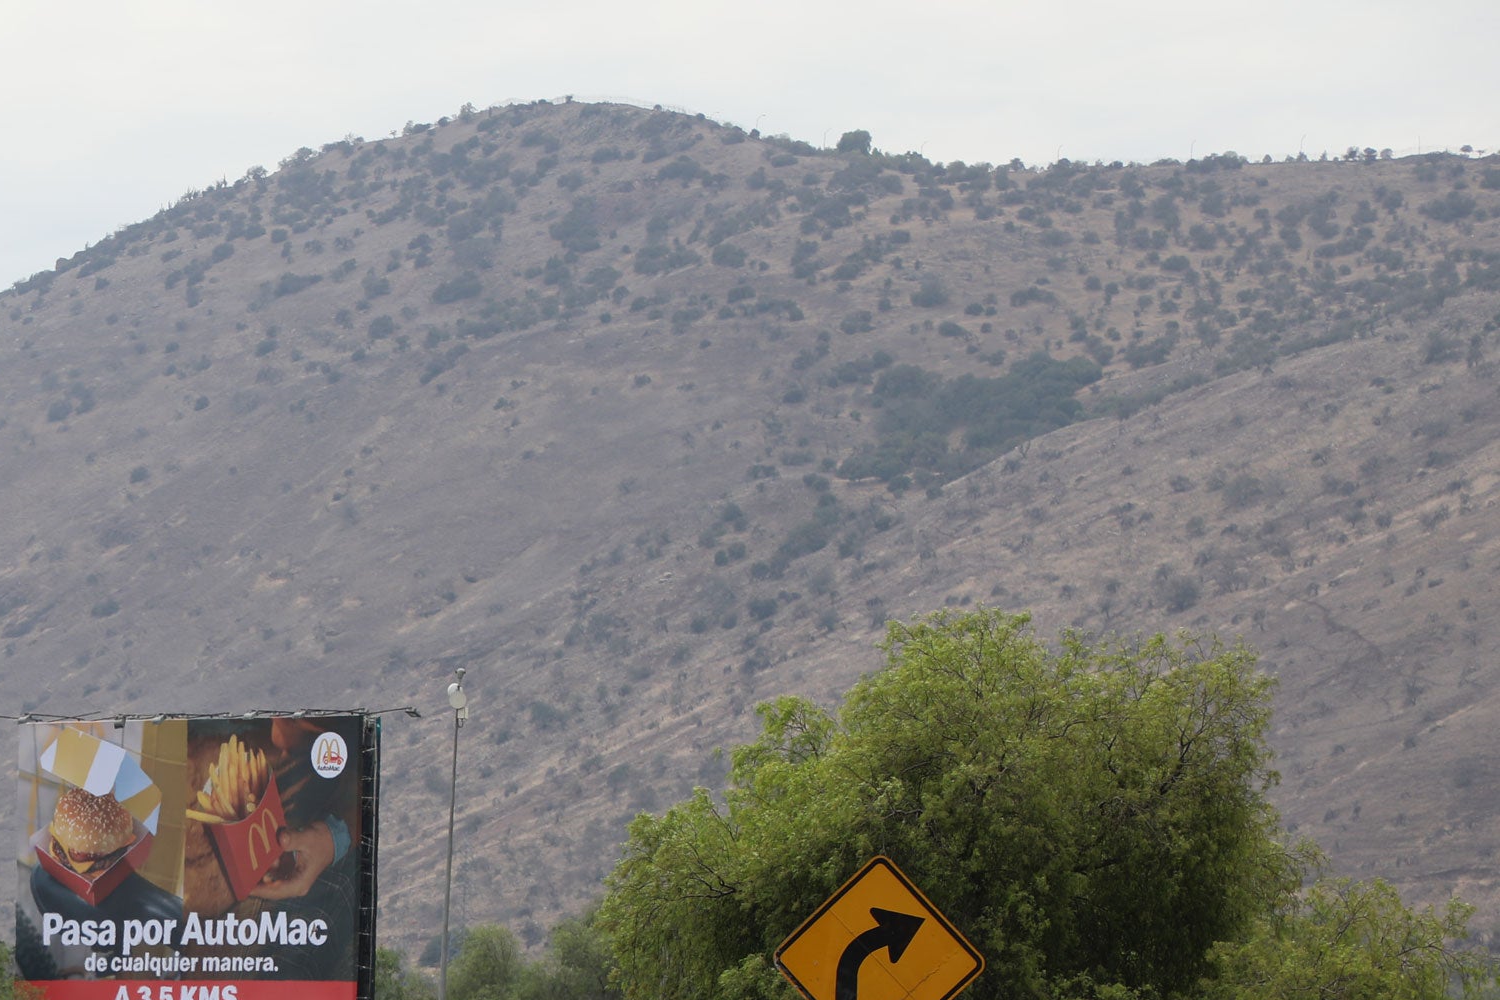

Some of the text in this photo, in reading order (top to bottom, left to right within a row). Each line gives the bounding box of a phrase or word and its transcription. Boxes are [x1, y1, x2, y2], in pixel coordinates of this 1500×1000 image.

[42, 911, 328, 955] Pasa por AutoMac
[84, 951, 279, 976] de cualquier manera.
